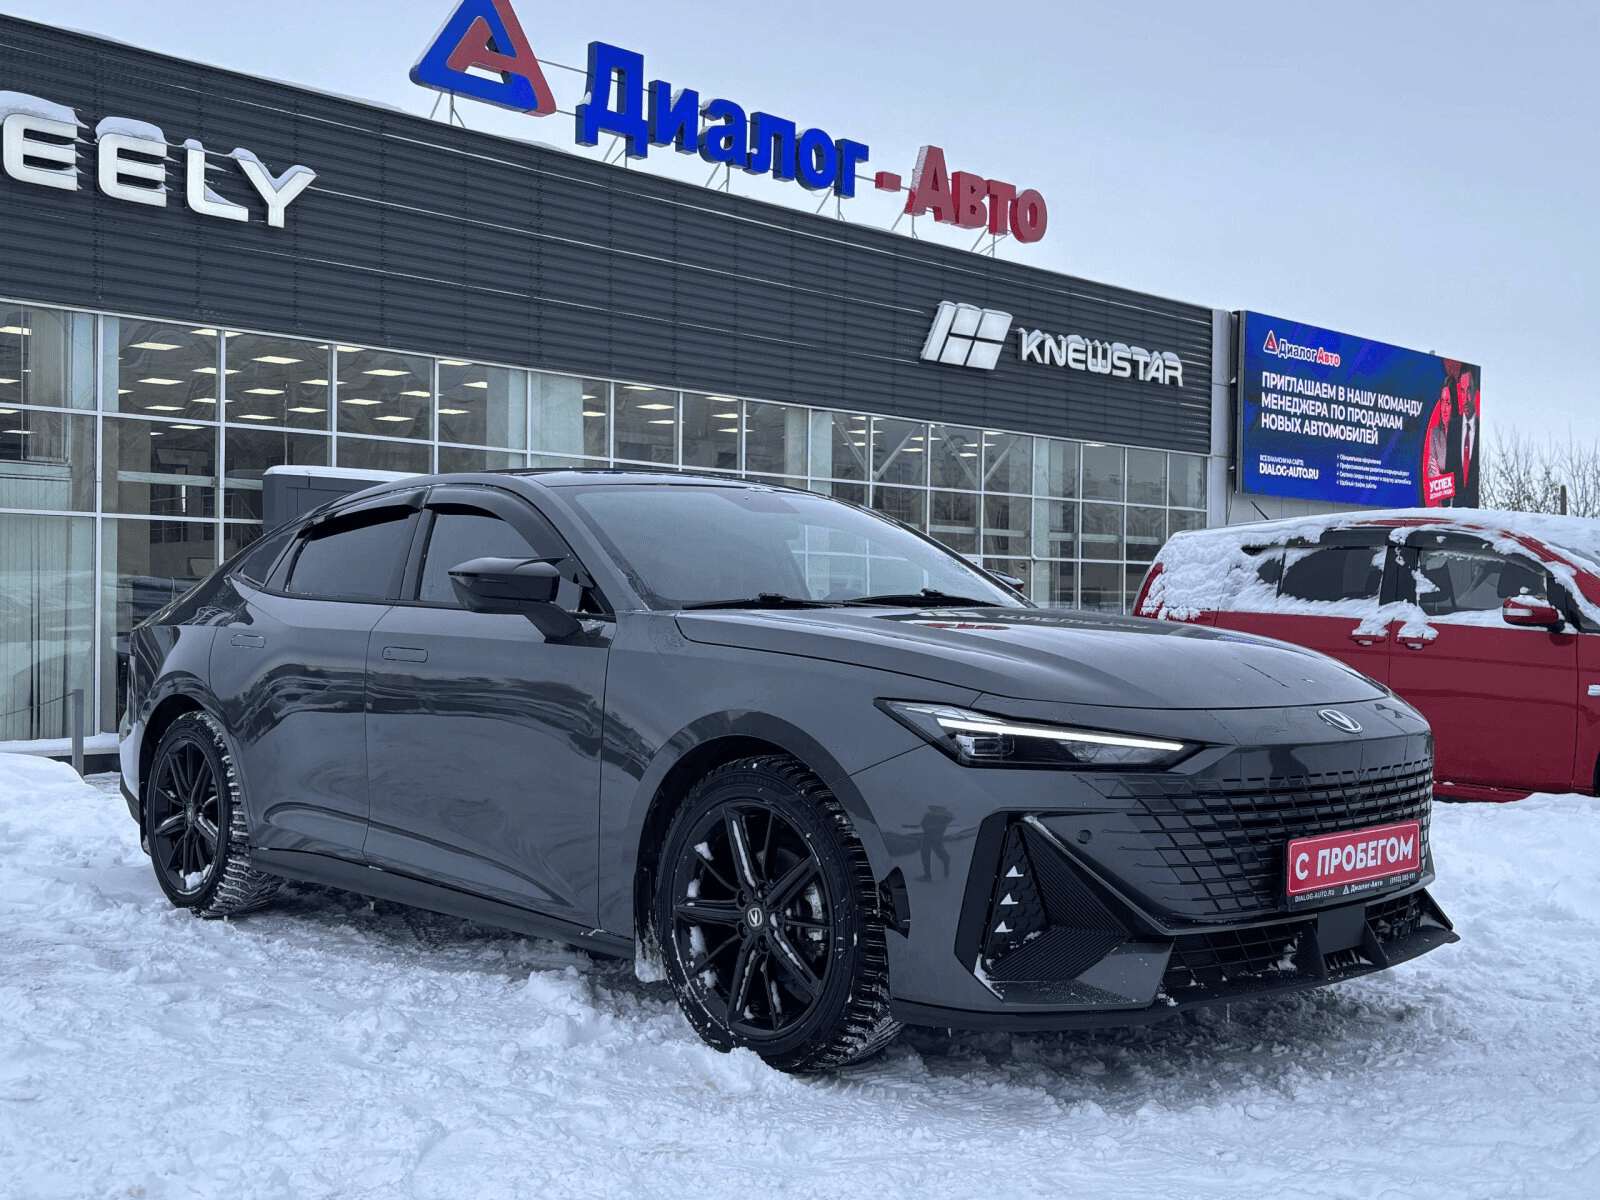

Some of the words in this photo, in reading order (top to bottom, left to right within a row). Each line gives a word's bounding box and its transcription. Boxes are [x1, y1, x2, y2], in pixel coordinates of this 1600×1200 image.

[1018, 329, 1184, 387] KNEWSTAR
[1261, 391, 1329, 418] МЕНЕДЖЕРА
[1330, 403, 1346, 420] ПО
[1347, 406, 1403, 430] ПРОДАЖАМ
[1262, 371, 1337, 401] ПРИГЛАШАЕМ
[1338, 385, 1346, 402] В
[1347, 387, 1377, 407] НАШУ
[1378, 393, 1423, 417] КОМАНДУ
[1261, 412, 1302, 434] НОВЫХ
[1303, 419, 1379, 445] АВТОМОБИЛЕЙ
[1259, 462, 1319, 480] DIALOG-AUTO.RU
[1295, 852, 1310, 880] С
[1316, 833, 1414, 877] ПРОБЕГОМ
